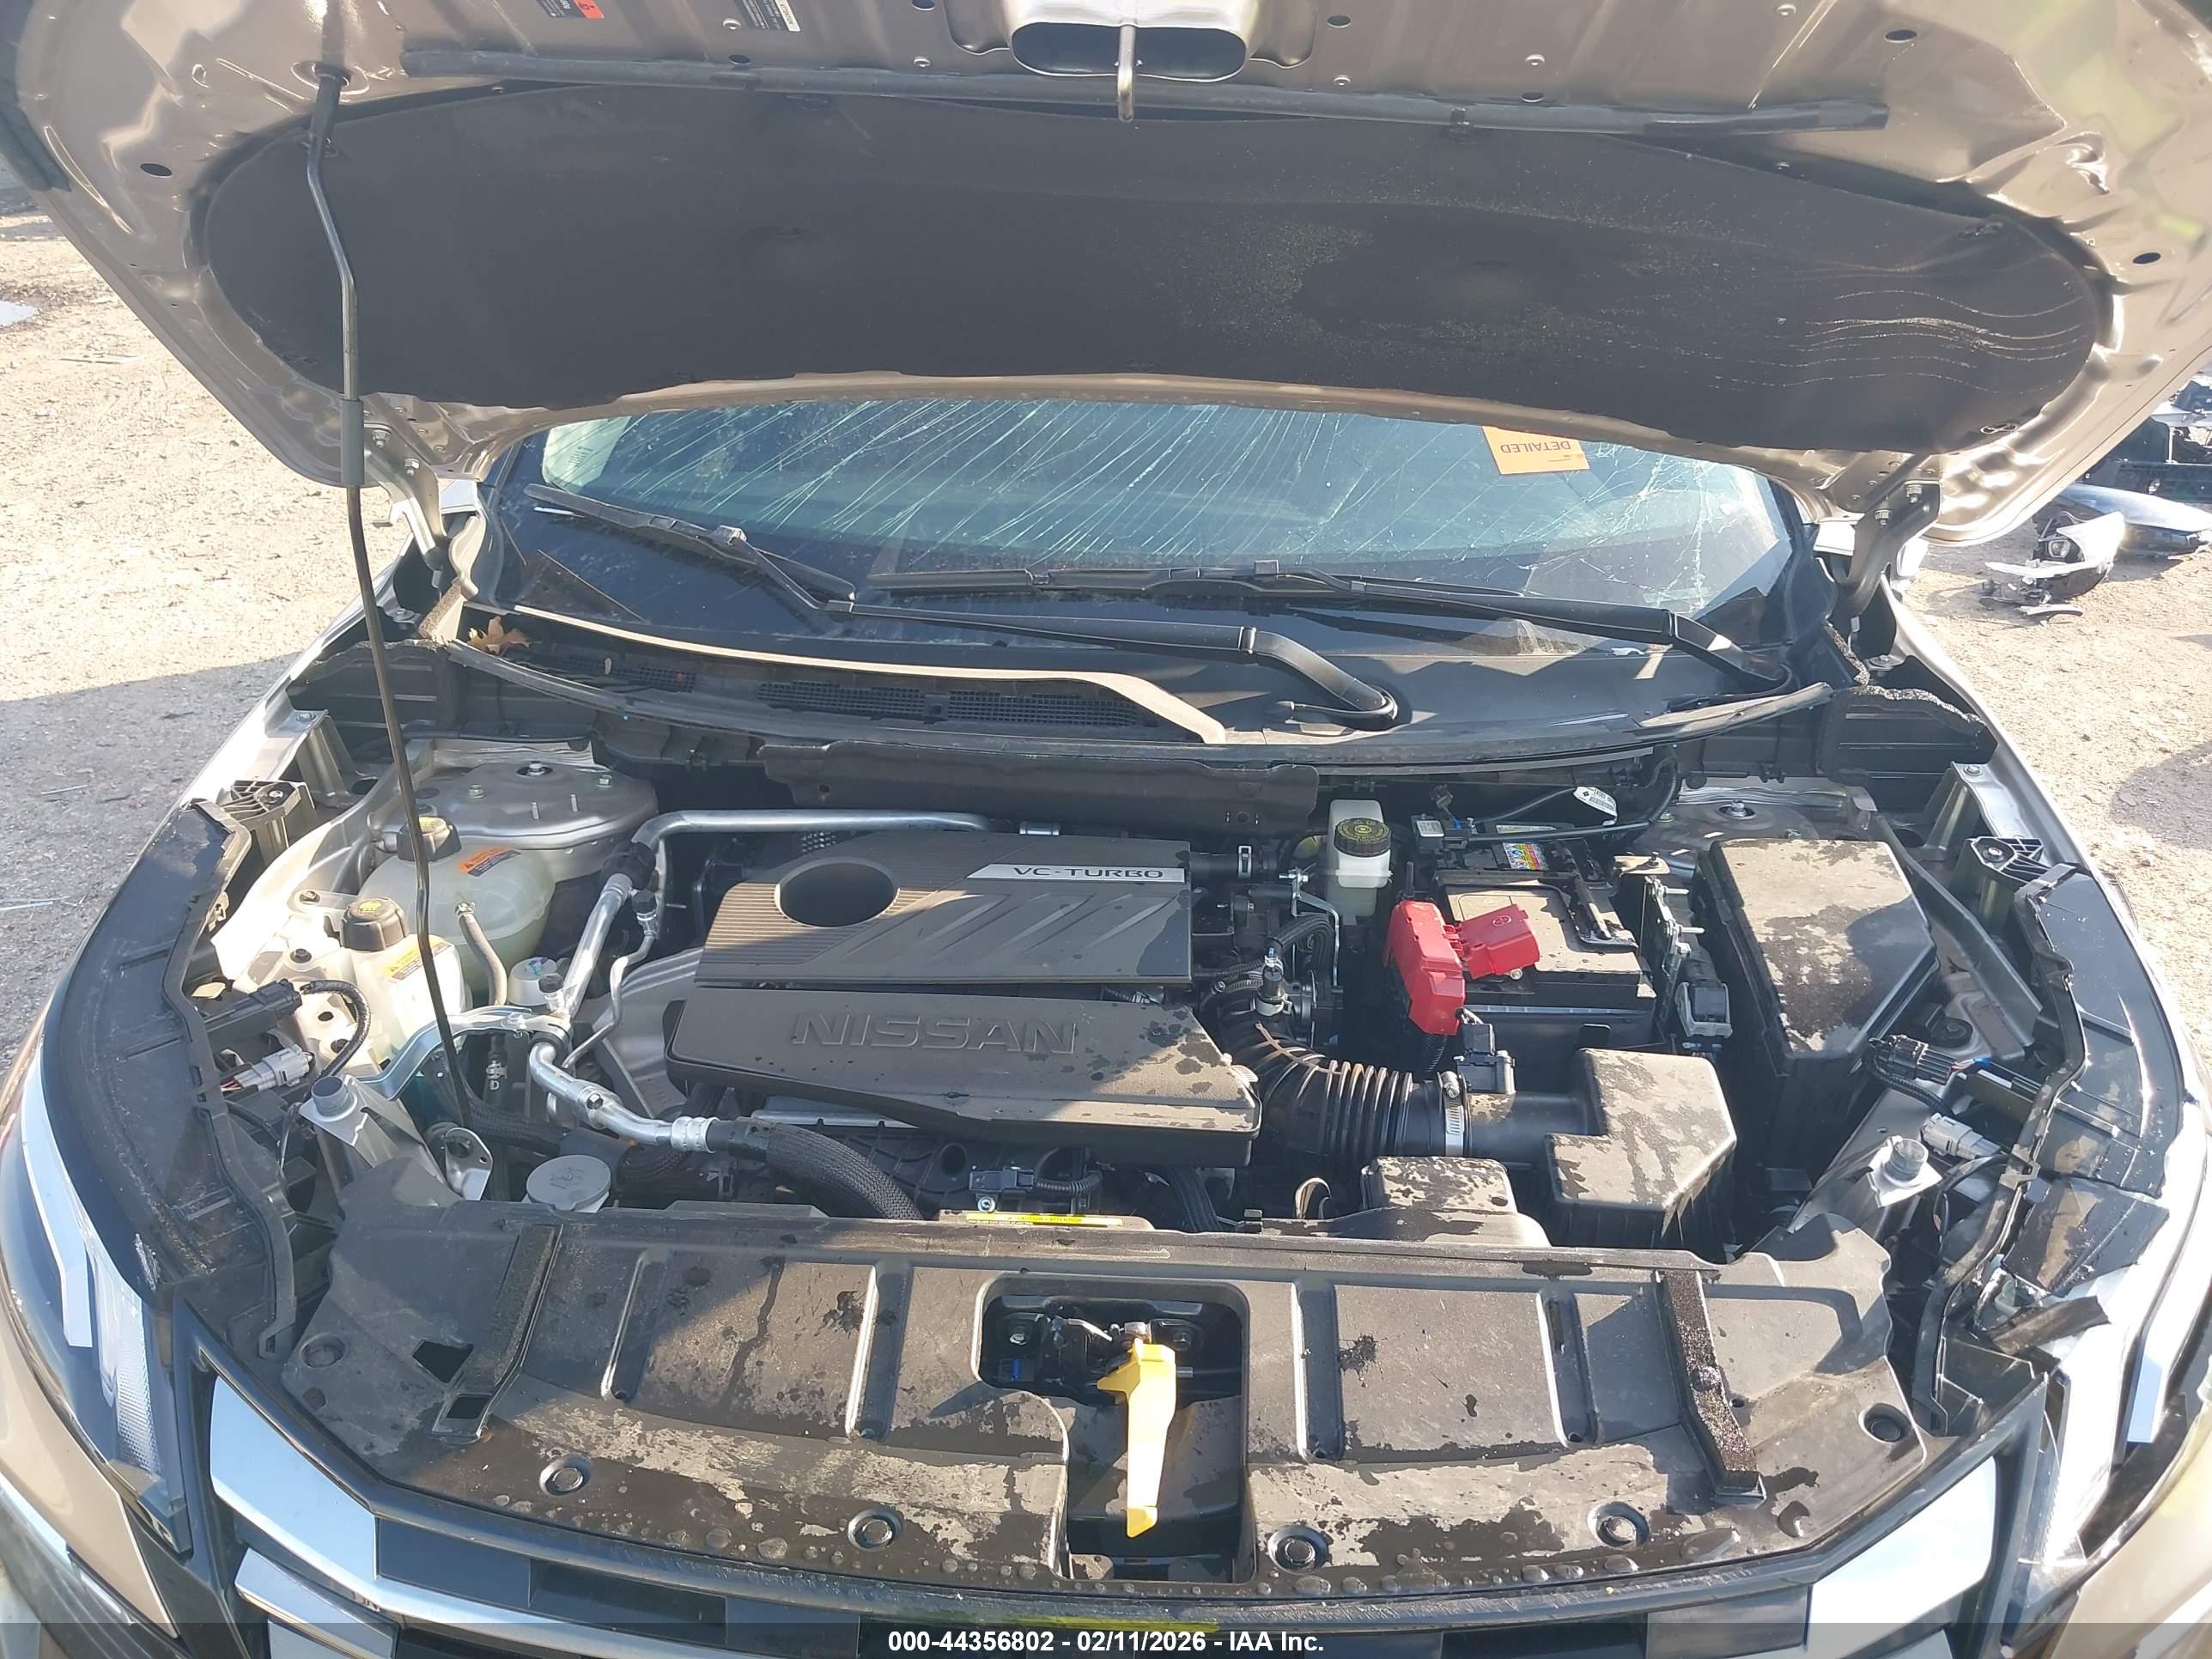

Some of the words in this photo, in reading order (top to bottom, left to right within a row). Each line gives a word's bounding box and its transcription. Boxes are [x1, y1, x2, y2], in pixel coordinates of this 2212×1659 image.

[1500, 441, 1571, 453] DETAILED
[1013, 867, 1164, 878] VC-TURBO
[792, 1013, 1077, 1054] NISSAN
